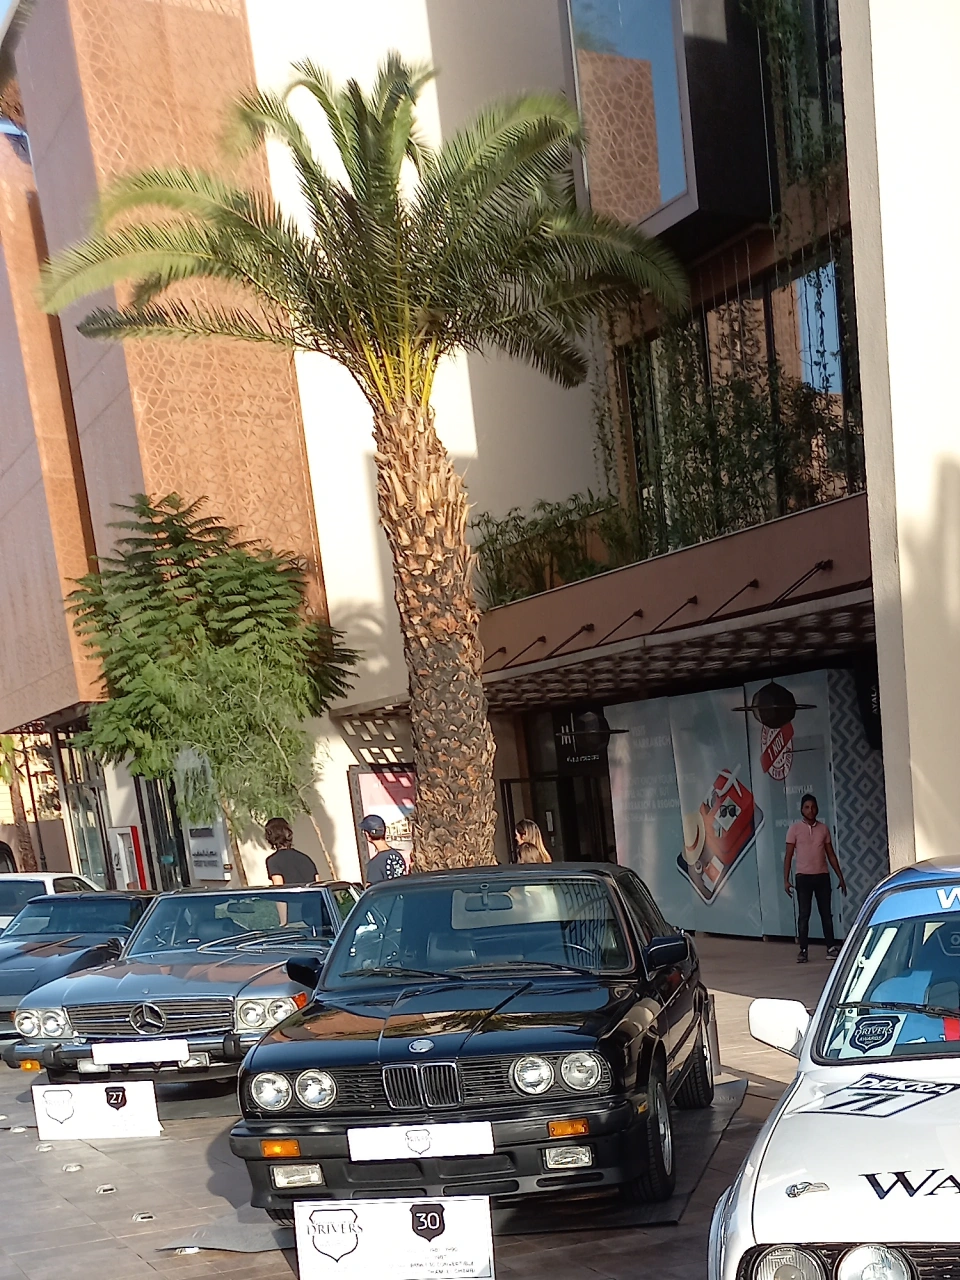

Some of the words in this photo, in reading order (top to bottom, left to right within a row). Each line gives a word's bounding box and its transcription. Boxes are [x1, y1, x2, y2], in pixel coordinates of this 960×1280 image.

[850, 1077, 954, 1093] DEKRA
[108, 1092, 123, 1104] 27
[415, 1213, 440, 1230] 30
[307, 1223, 363, 1236] DRIVERS
